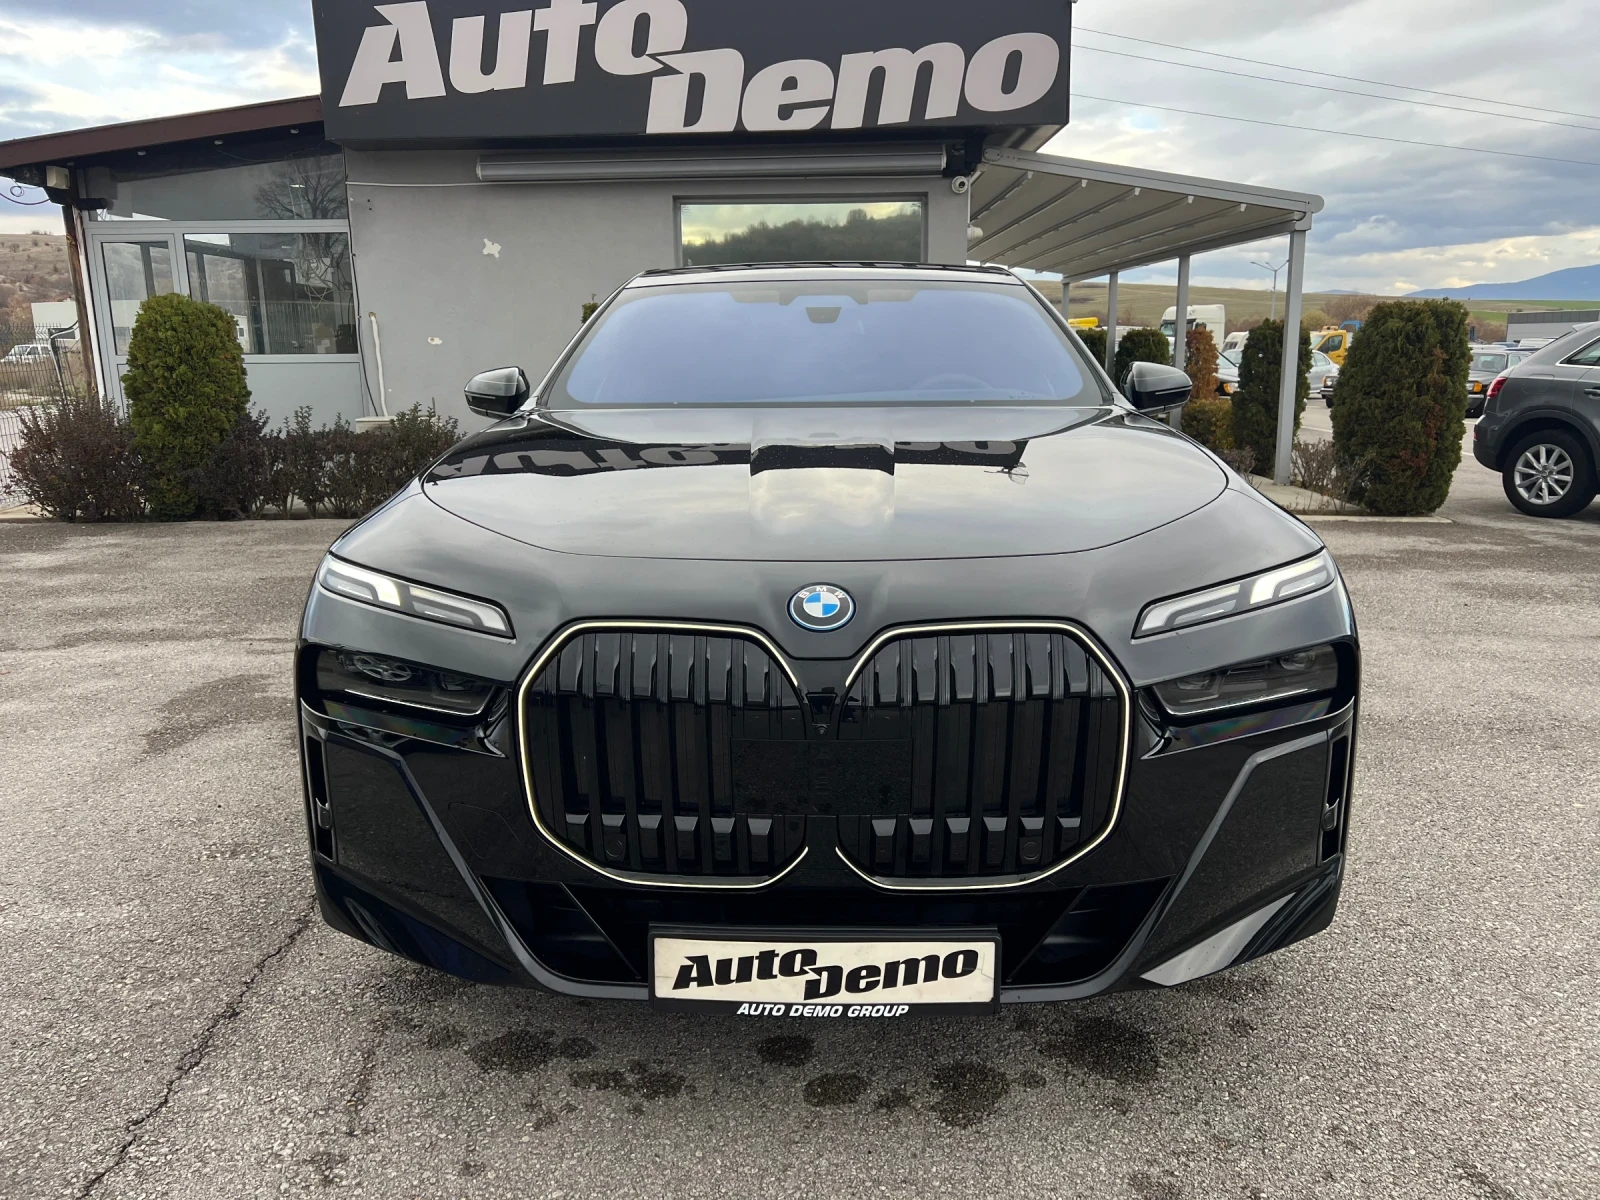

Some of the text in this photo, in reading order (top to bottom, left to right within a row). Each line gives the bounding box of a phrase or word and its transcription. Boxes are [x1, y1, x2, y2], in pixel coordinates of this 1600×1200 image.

[338, 0, 1060, 134] Auto Demo
[672, 948, 979, 1001] Auto Demo
[736, 1003, 909, 1018] AUTO DEMO GROUP
